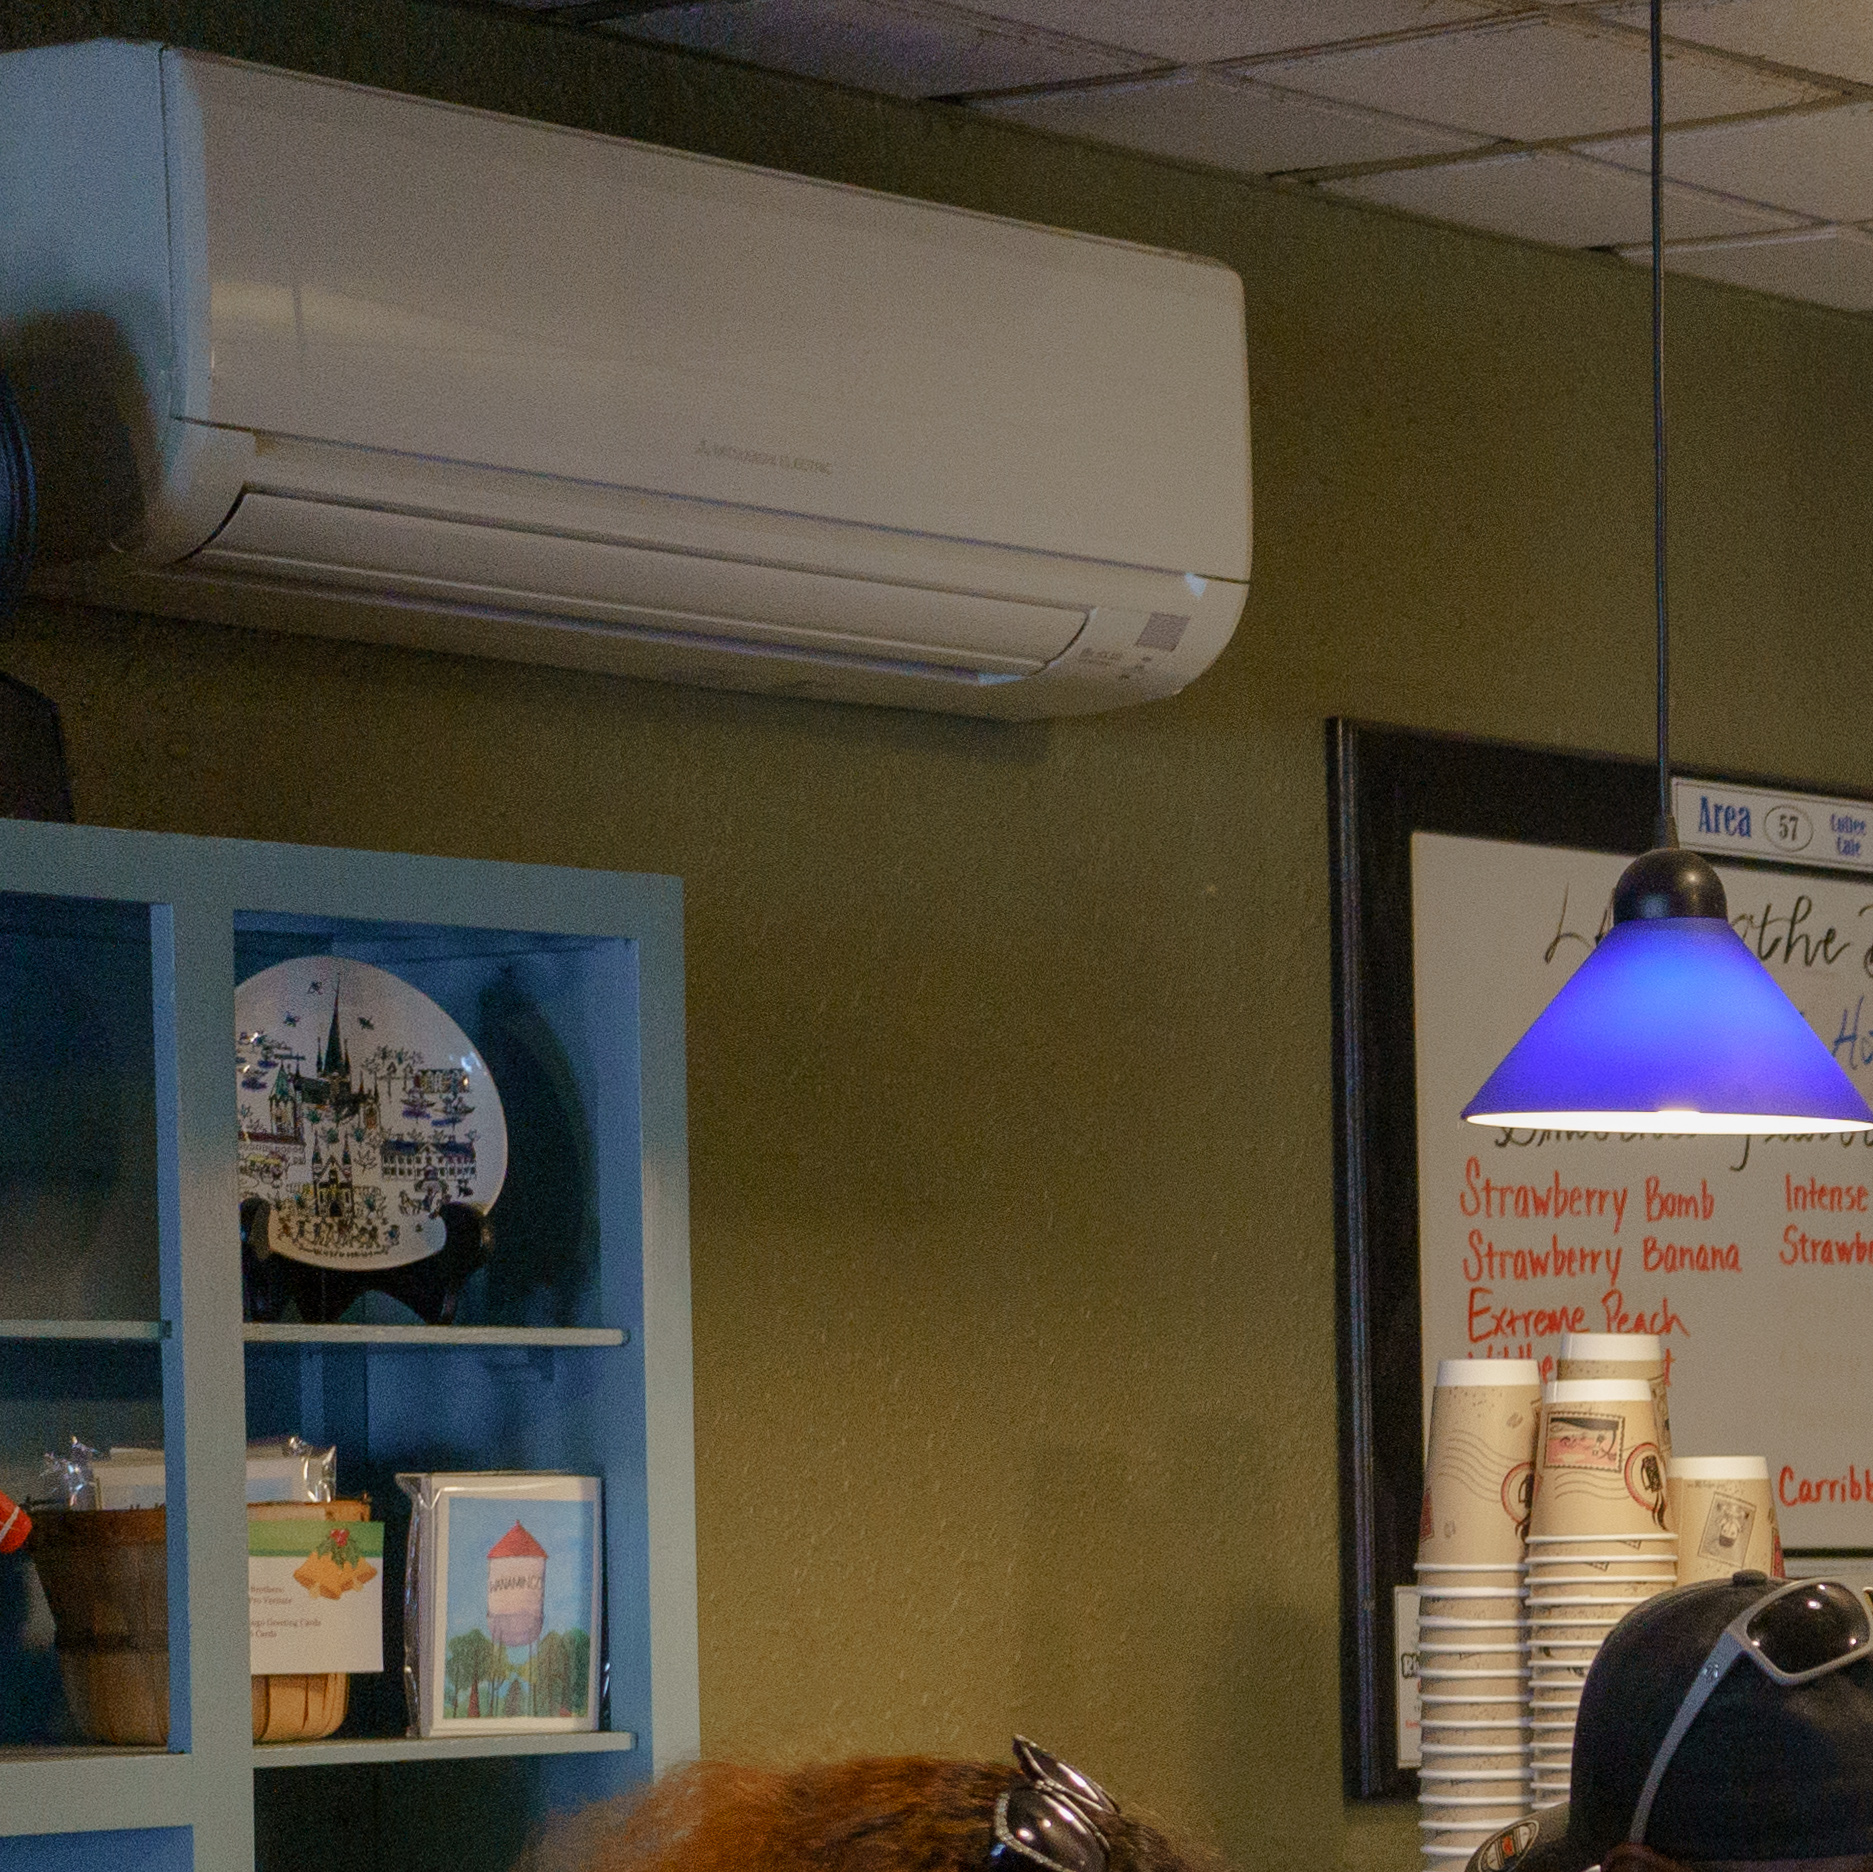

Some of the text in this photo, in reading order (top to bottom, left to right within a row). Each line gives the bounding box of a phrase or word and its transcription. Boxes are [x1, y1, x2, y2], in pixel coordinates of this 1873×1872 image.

[1697, 795, 1799, 842] Area 57
[1460, 1156, 1715, 1235] Strawberry Bomb
[1784, 1173, 1871, 1215] Intense
[1463, 1228, 1742, 1288] Strawberry Banana
[1468, 1286, 1691, 1344] Extreme Peach
